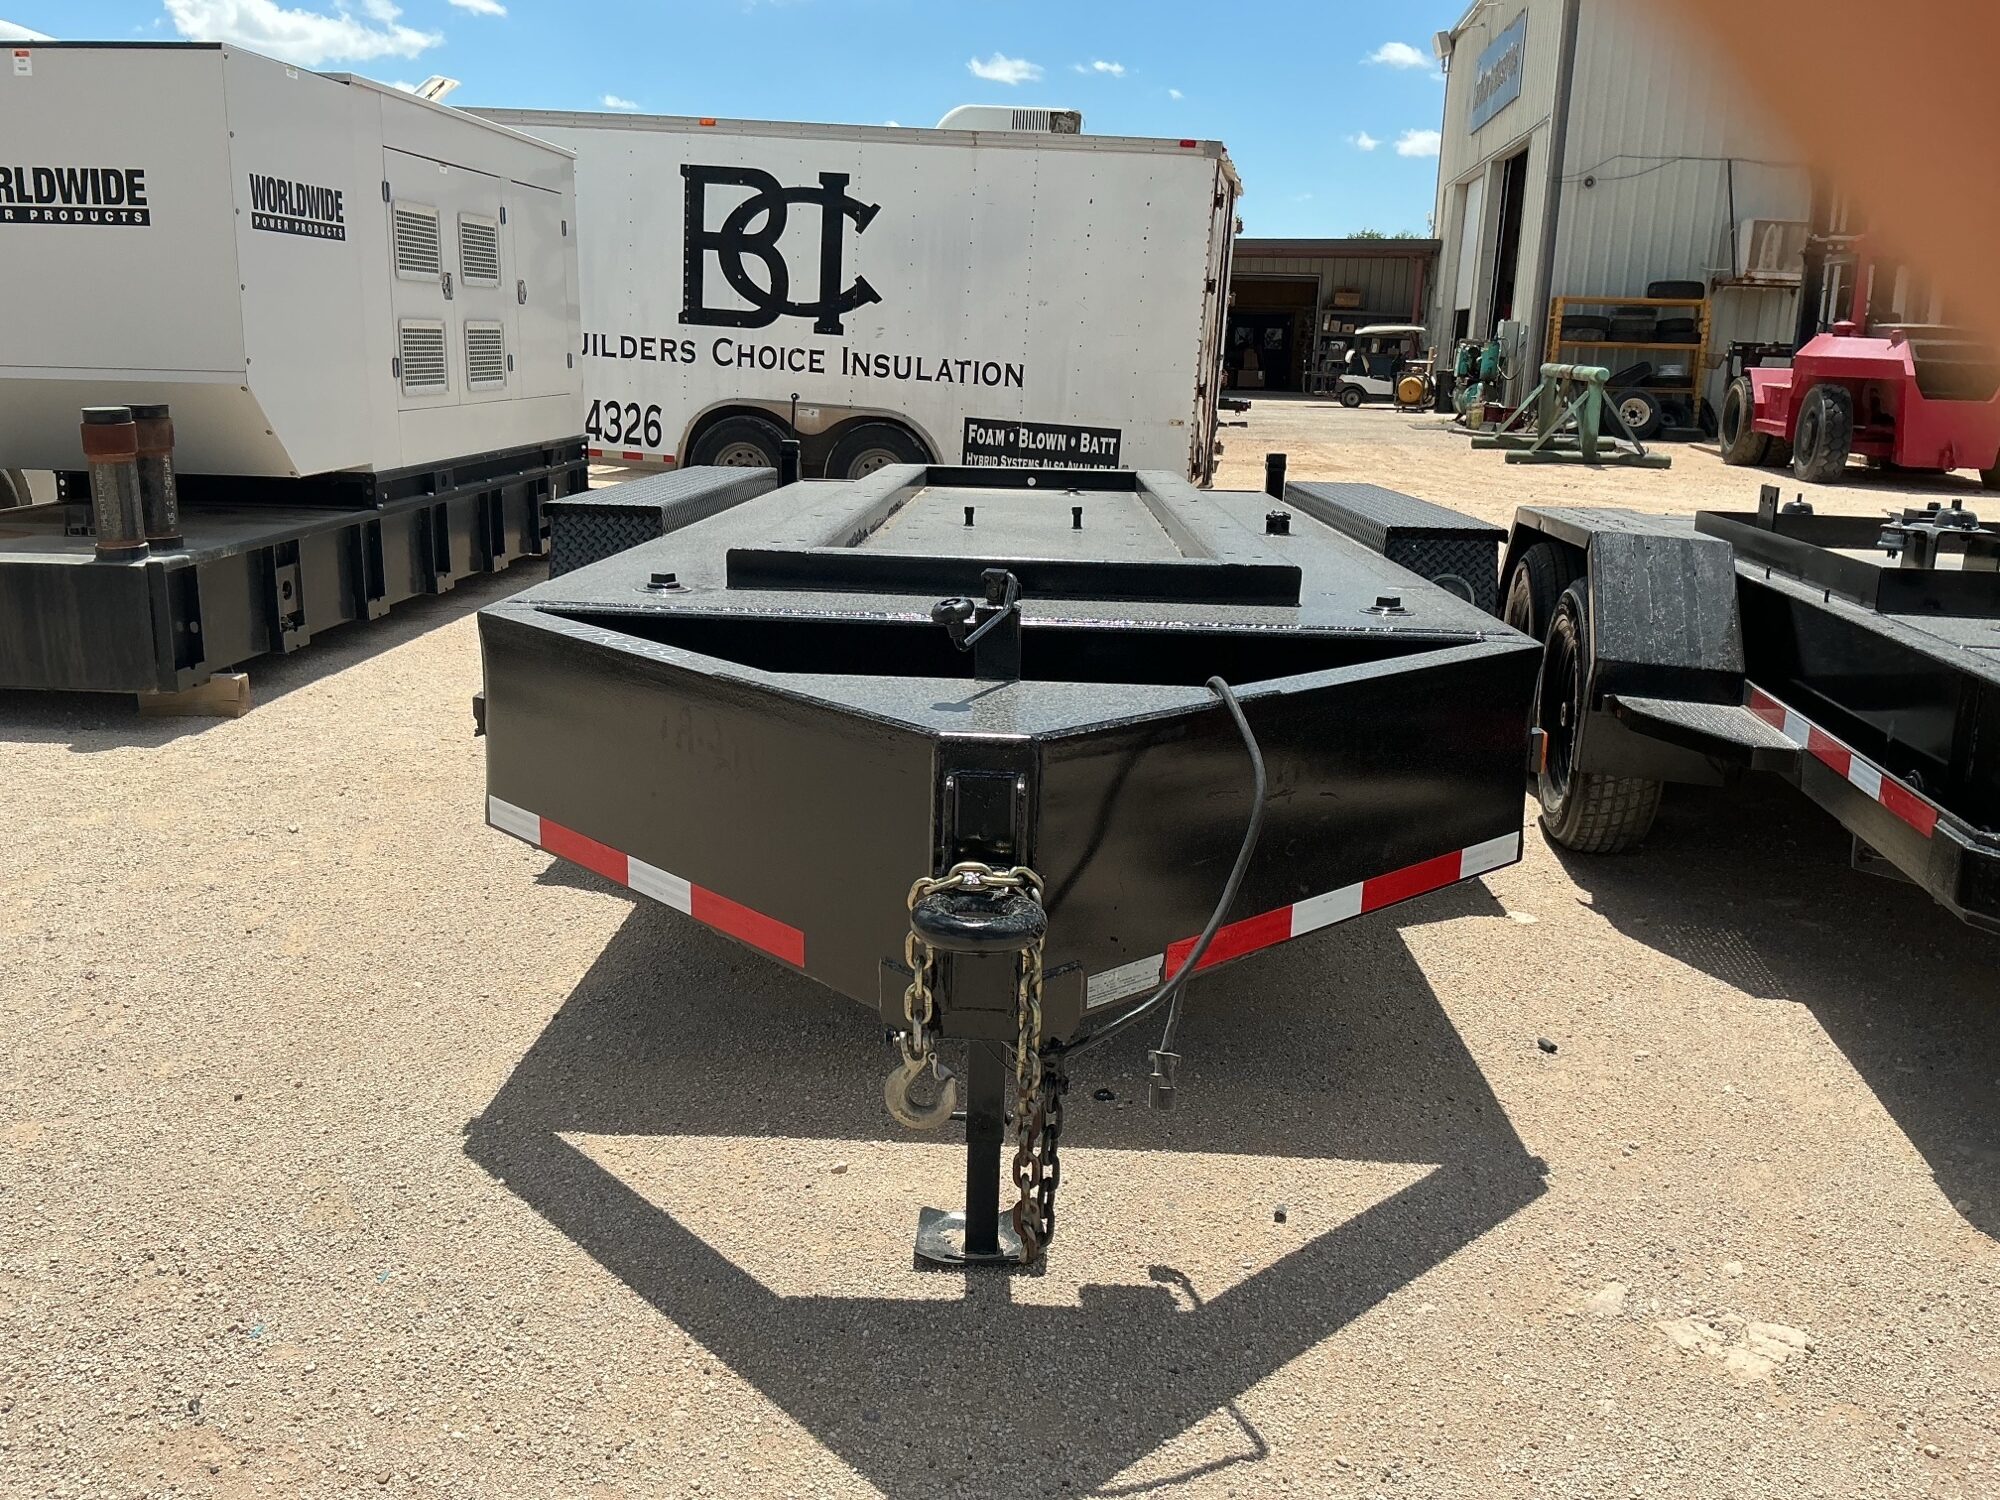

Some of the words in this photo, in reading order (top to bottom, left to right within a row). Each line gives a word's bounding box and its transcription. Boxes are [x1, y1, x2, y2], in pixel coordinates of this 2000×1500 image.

[249, 173, 344, 223] WORLDWIDE
[29, 209, 143, 223] PRODUCTS
[255, 216, 289, 231] POWER
[295, 221, 343, 238] PRODUCTS
[712, 337, 825, 374] CHOICE
[842, 346, 1025, 388] INSULATION
[585, 399, 662, 448] 4326
[968, 424, 1005, 447] FOAM
[1018, 428, 1067, 451] BLOWN
[1080, 432, 1117, 455] BATT
[966, 451, 998, 467] HYBRID
[1000, 455, 1040, 468] SYSTEMS
